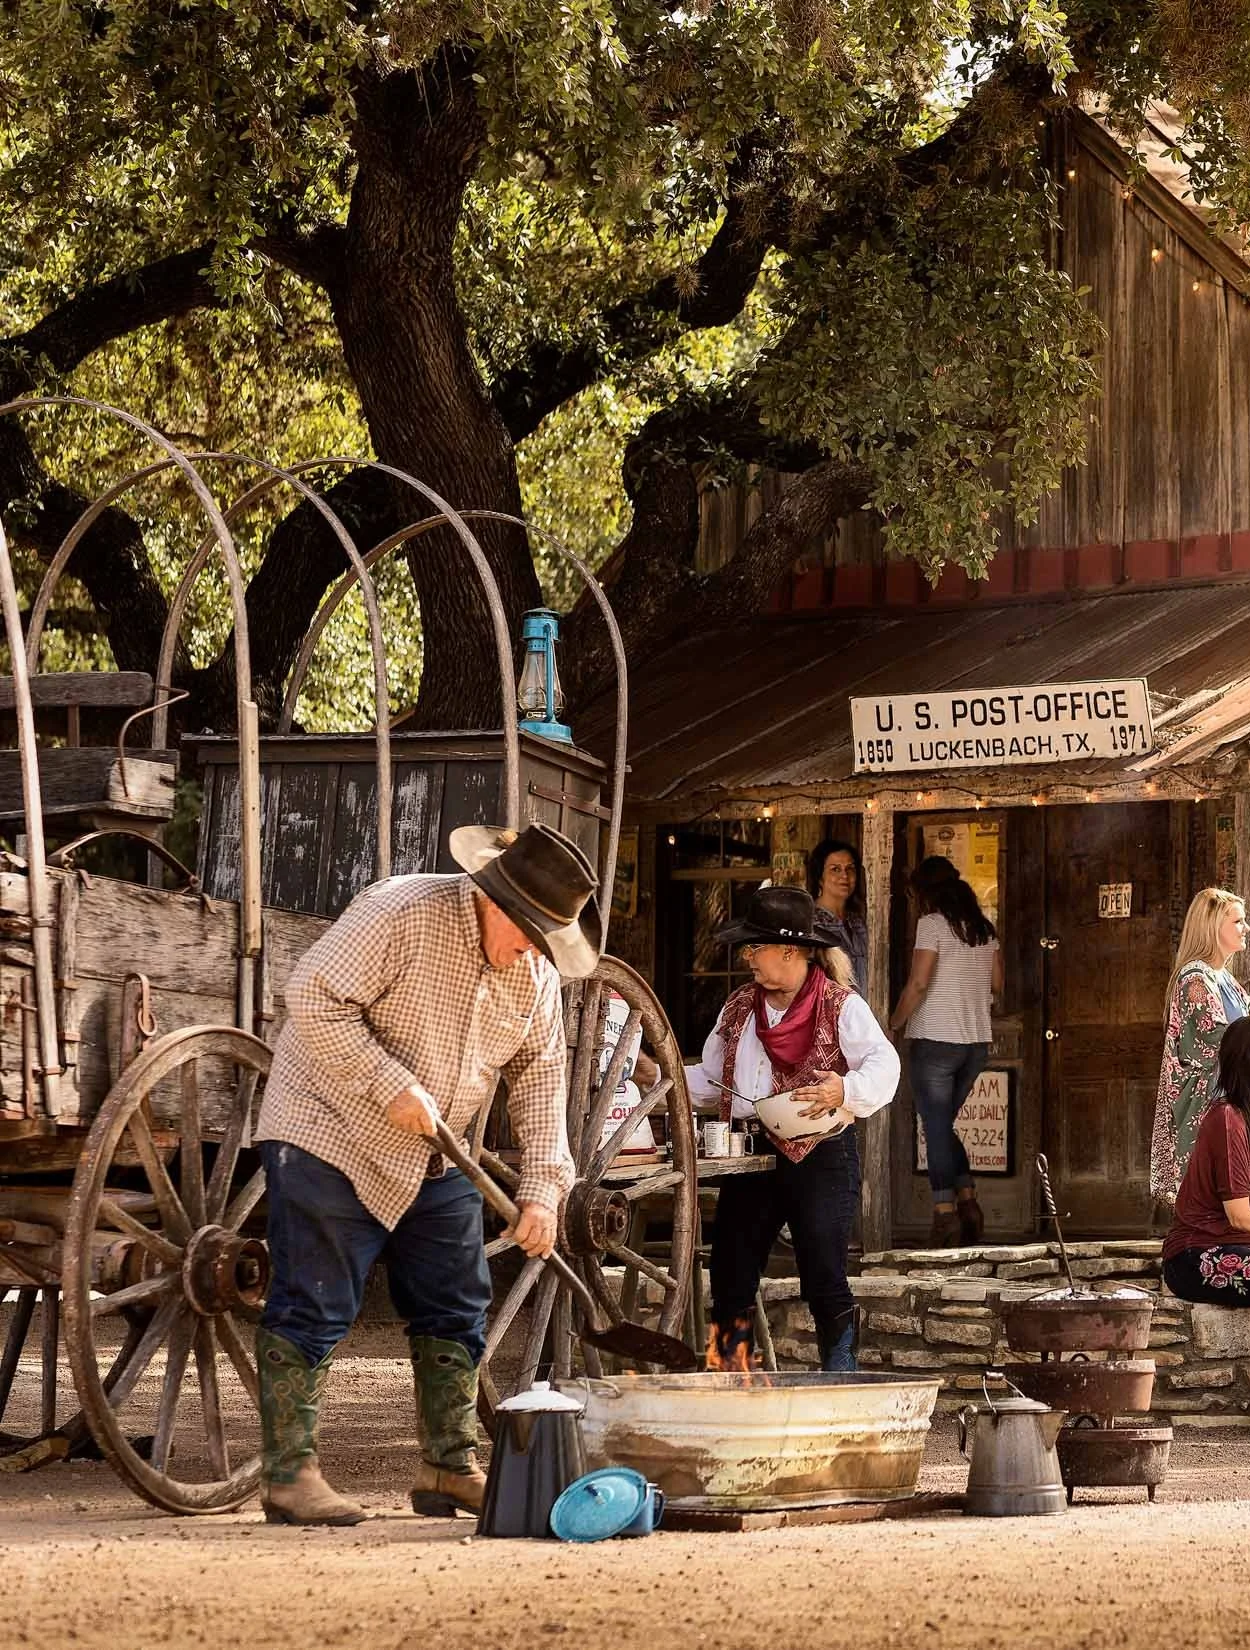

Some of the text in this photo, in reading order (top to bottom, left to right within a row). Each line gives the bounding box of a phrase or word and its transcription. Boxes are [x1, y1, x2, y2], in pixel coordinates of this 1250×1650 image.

[876, 689, 1129, 732] U. S. POST-OFFICE
[858, 739, 894, 765] 1850
[908, 734, 1059, 763] LUCKENBACH,
[1110, 724, 1147, 750] 1971
[1101, 892, 1130, 911] OPEN
[978, 1079, 1001, 1098] AM
[980, 1104, 1008, 1121] DAILY
[955, 1127, 1004, 1148] 7-3224
